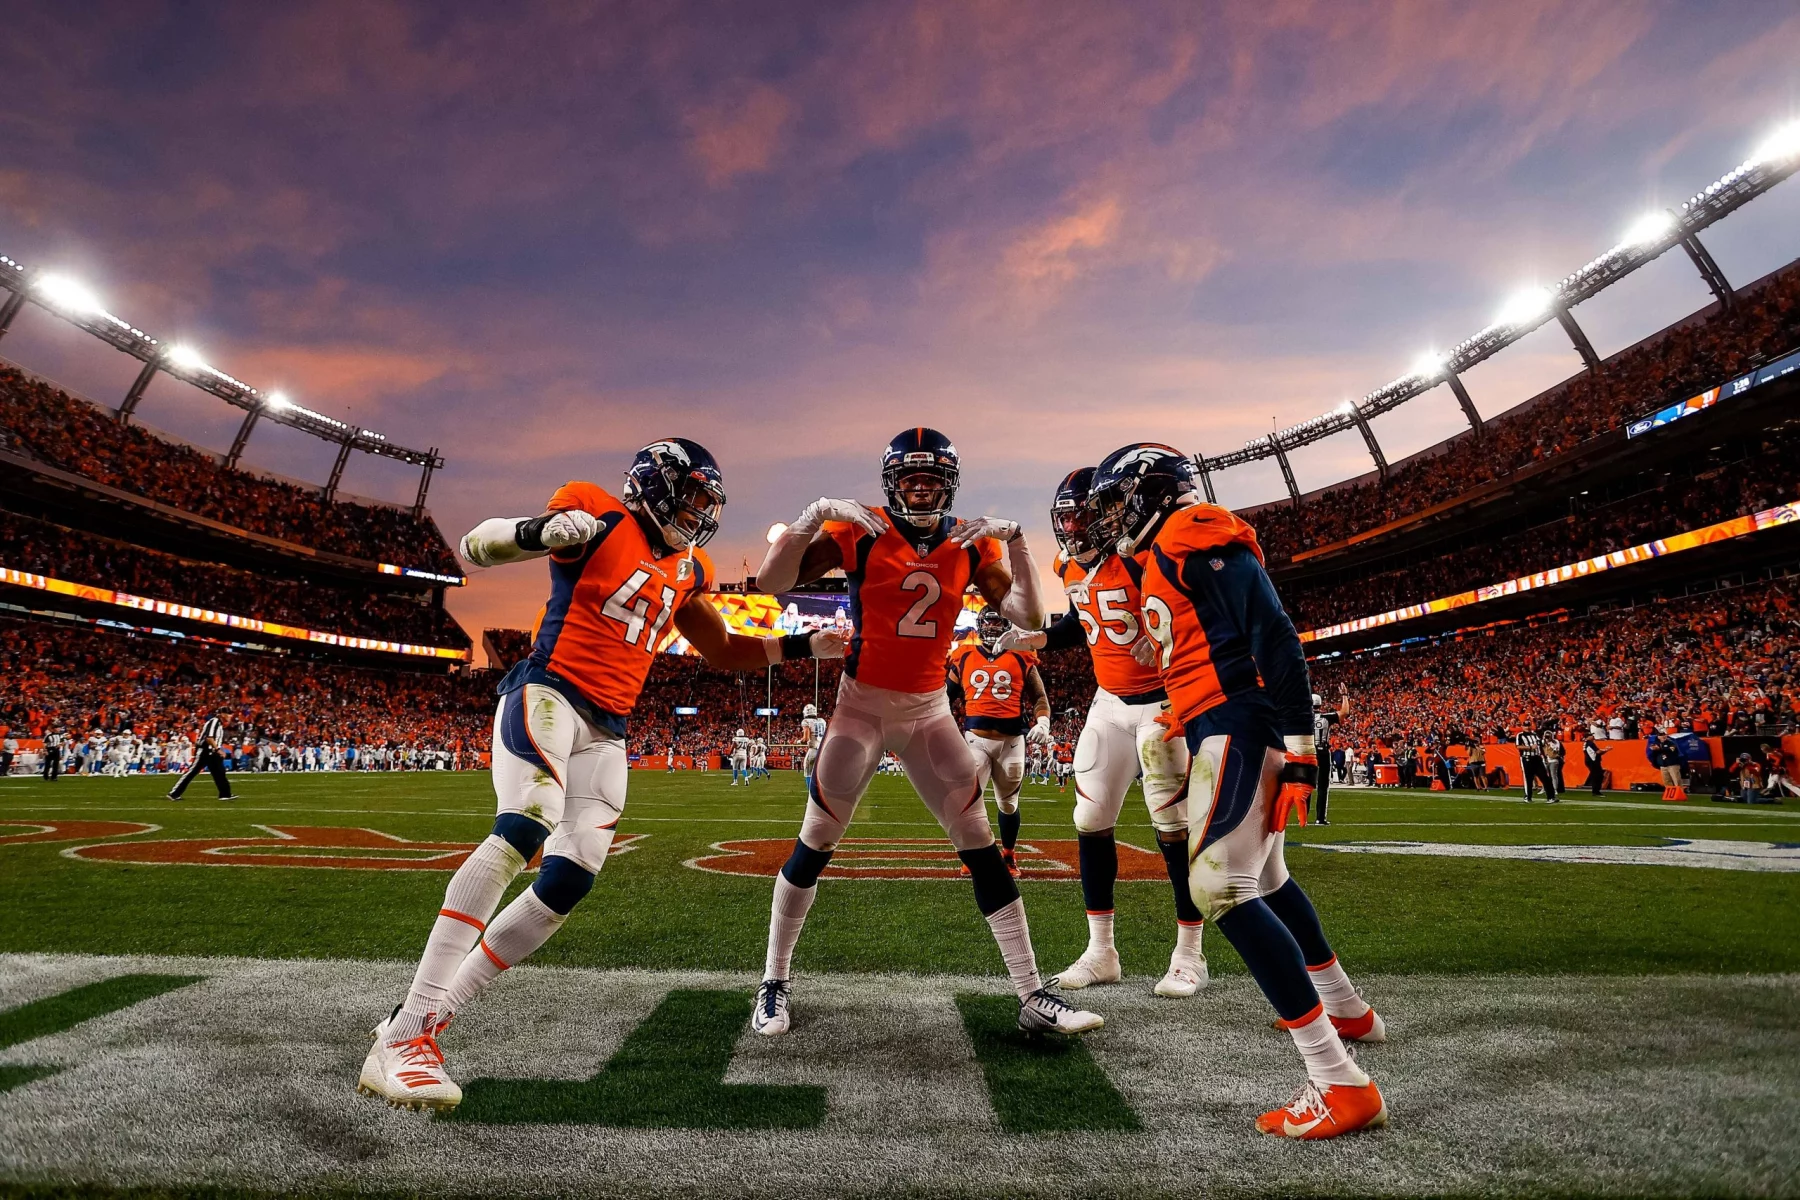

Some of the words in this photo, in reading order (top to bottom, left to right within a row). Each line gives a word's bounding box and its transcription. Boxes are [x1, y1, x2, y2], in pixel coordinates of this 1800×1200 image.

[640, 560, 668, 578] BRONCOS
[905, 561, 939, 569] BRONCOS
[601, 568, 676, 654] 41
[897, 570, 941, 638] 2
[1141, 594, 1174, 671] 9
[969, 669, 1012, 700] 98
[1376, 771, 1382, 779] G
[1666, 787, 1677, 798] 10
